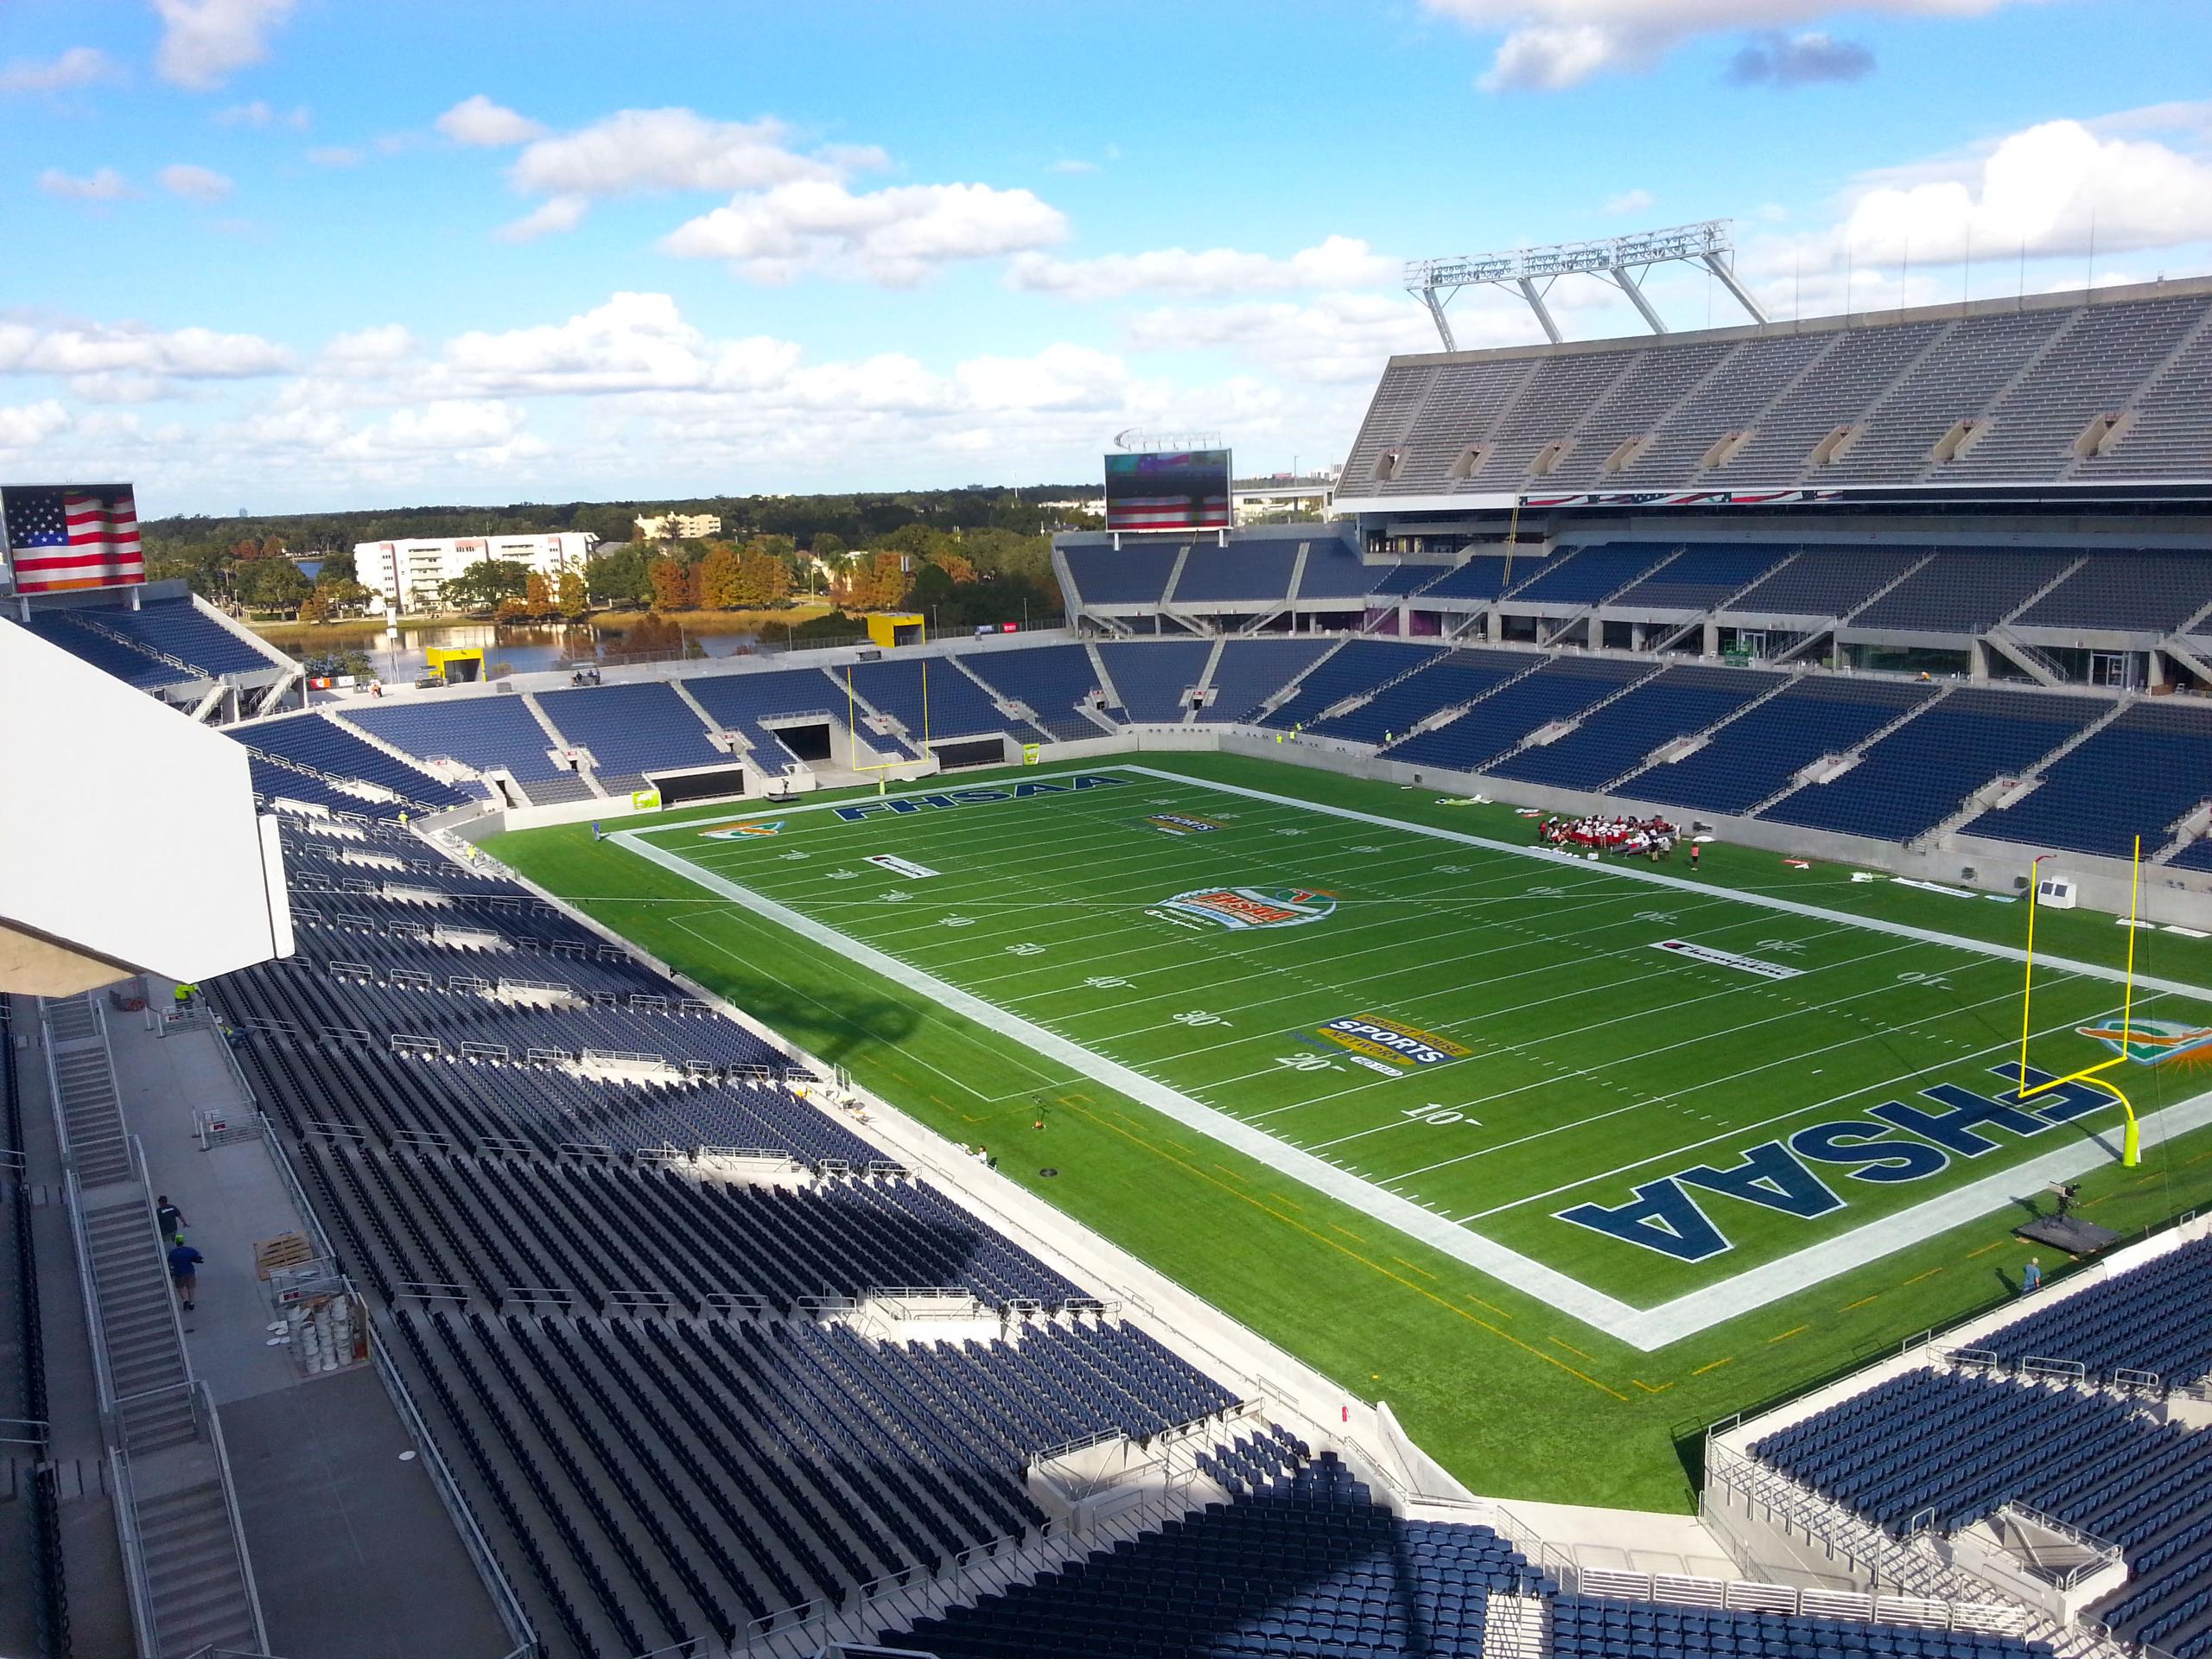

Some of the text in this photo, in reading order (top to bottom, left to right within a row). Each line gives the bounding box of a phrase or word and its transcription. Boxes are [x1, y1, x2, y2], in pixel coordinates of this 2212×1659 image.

[833, 776, 1134, 822] FHSAA
[1151, 814, 1214, 830] SPORTS
[1194, 892, 1299, 922] FHSAA
[1005, 943, 1046, 956] 50
[1756, 939, 1806, 951] 20
[1662, 943, 1785, 976] Champion
[1084, 976, 1127, 988] 40
[1897, 971, 1950, 987] 10
[1173, 1010, 1221, 1027] 30
[1329, 1020, 1445, 1063] SPORTS
[1362, 1015, 1463, 1053] BRIGHT HOUSE
[1329, 1031, 1402, 1061] NETWORK
[1274, 1052, 1332, 1071] 20
[1401, 1103, 1464, 1125] 10
[1550, 1061, 2122, 1264] FHSAA
